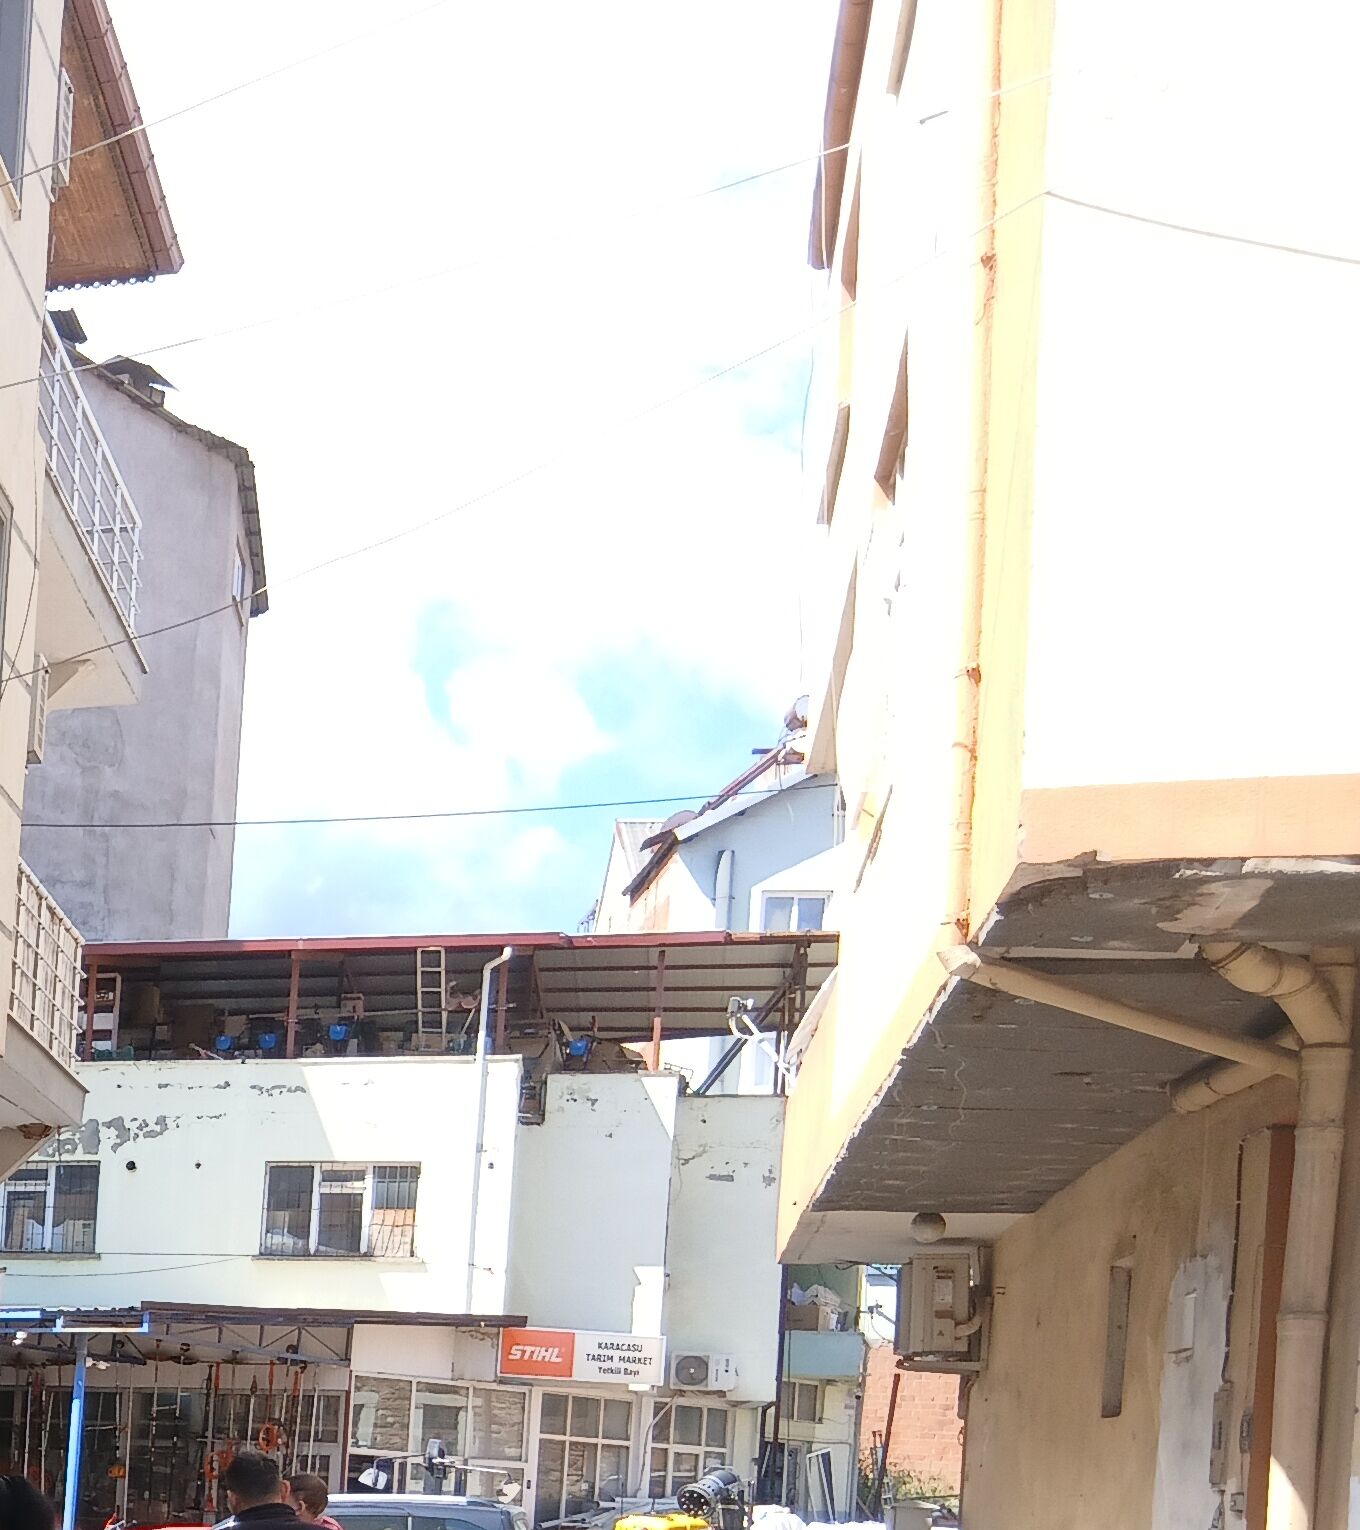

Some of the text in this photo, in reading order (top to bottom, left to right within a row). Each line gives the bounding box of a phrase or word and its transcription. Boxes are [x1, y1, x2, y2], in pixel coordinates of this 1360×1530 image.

[508, 1344, 563, 1363] STIHL
[597, 1341, 643, 1353] KARACASU
[585, 1353, 653, 1366] TARIM MARKET
